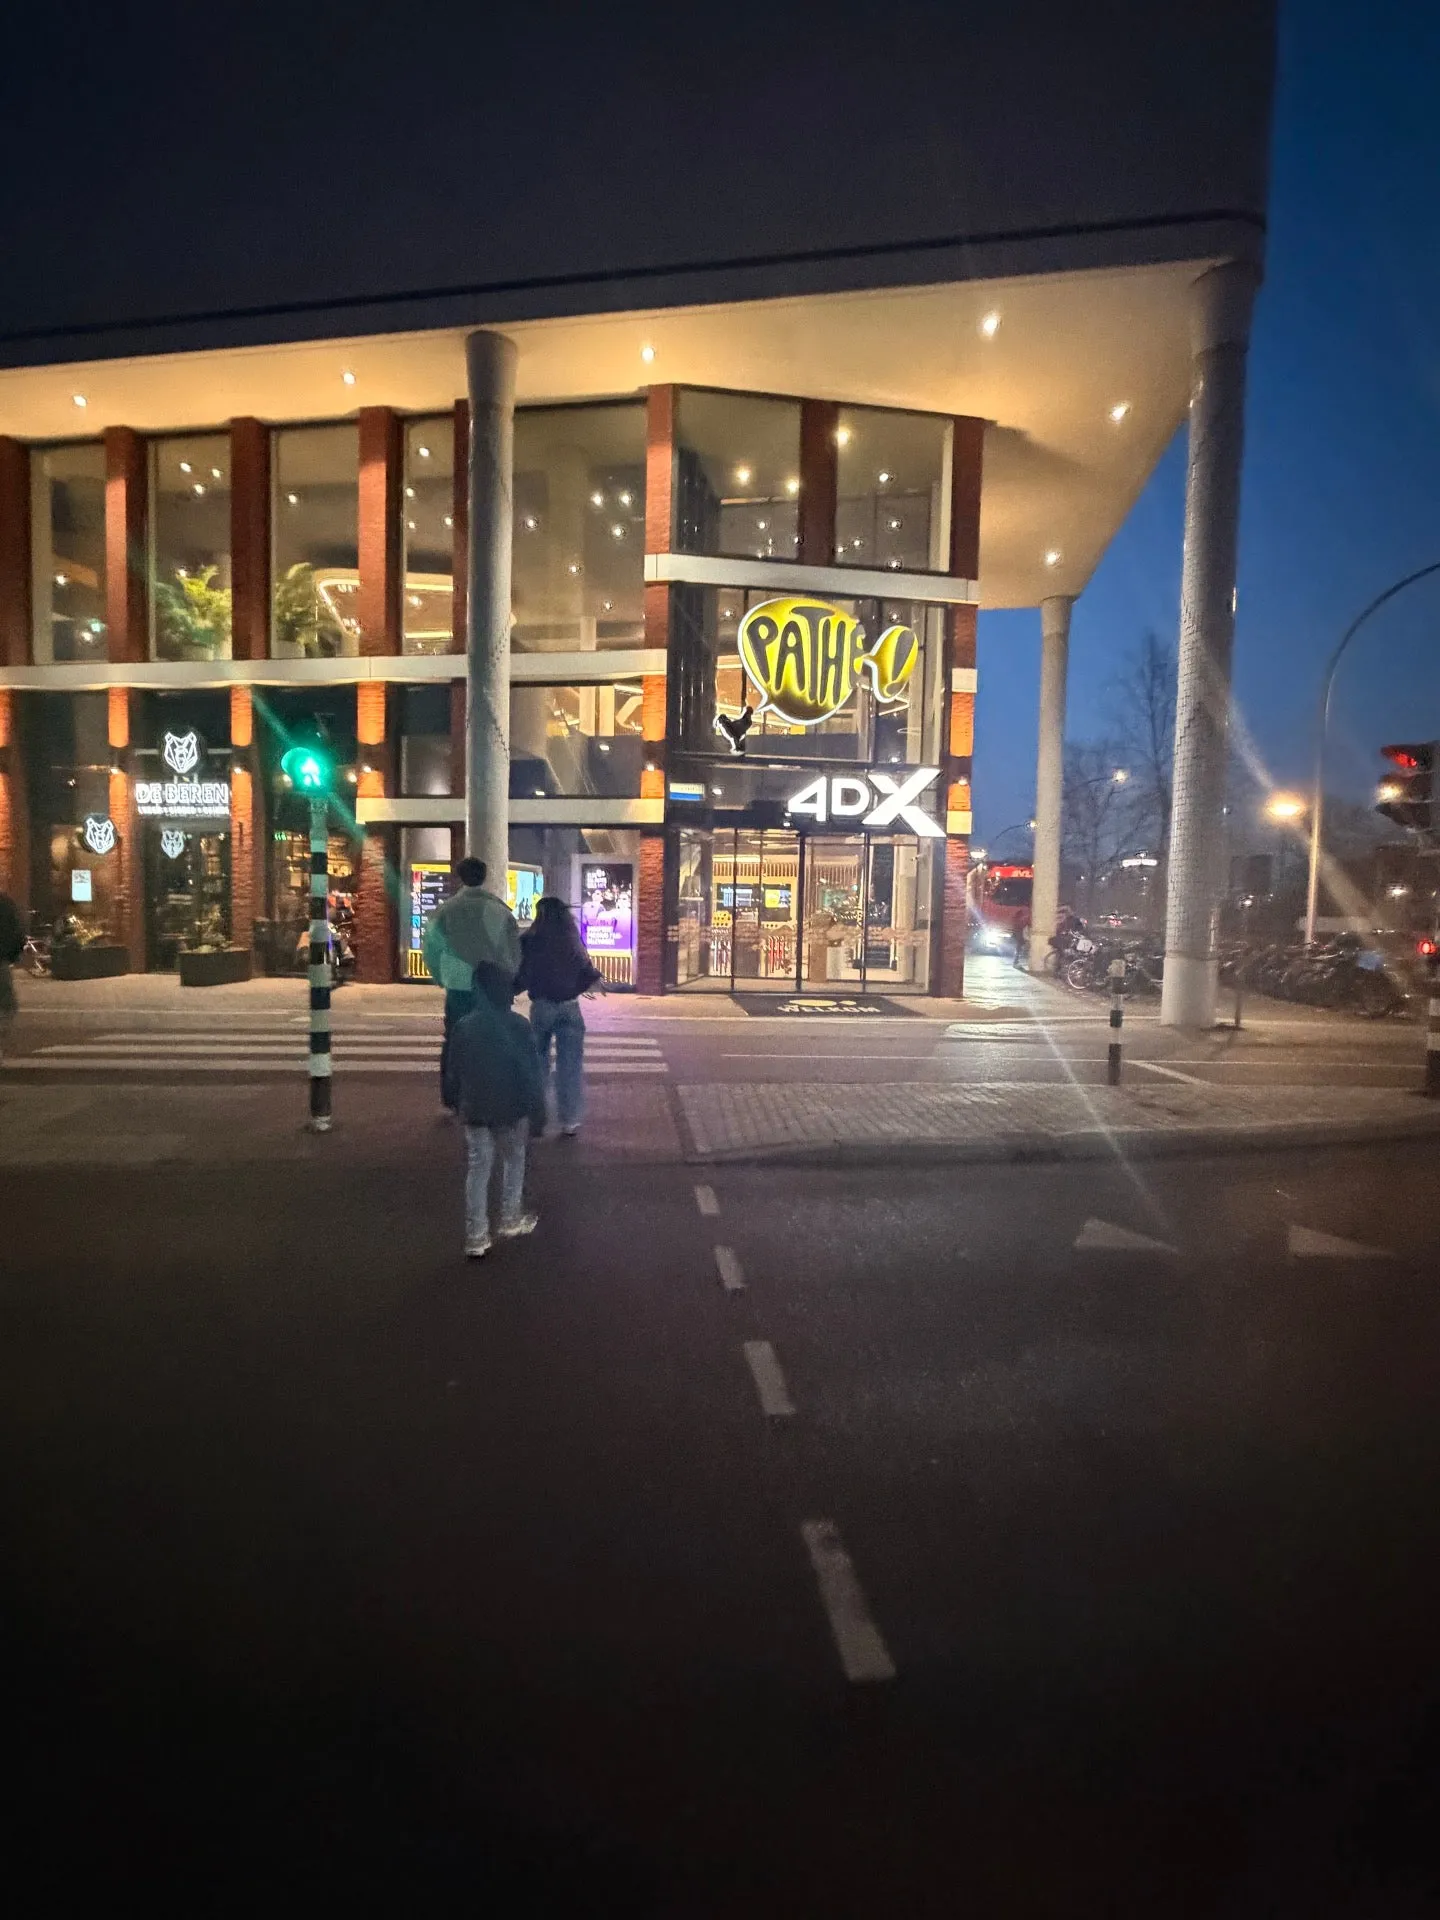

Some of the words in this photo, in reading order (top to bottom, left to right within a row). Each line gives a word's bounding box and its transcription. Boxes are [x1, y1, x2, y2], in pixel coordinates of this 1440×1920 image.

[135, 783, 162, 804] DE
[165, 783, 229, 804] BEREN
[787, 767, 947, 838] 4DX
